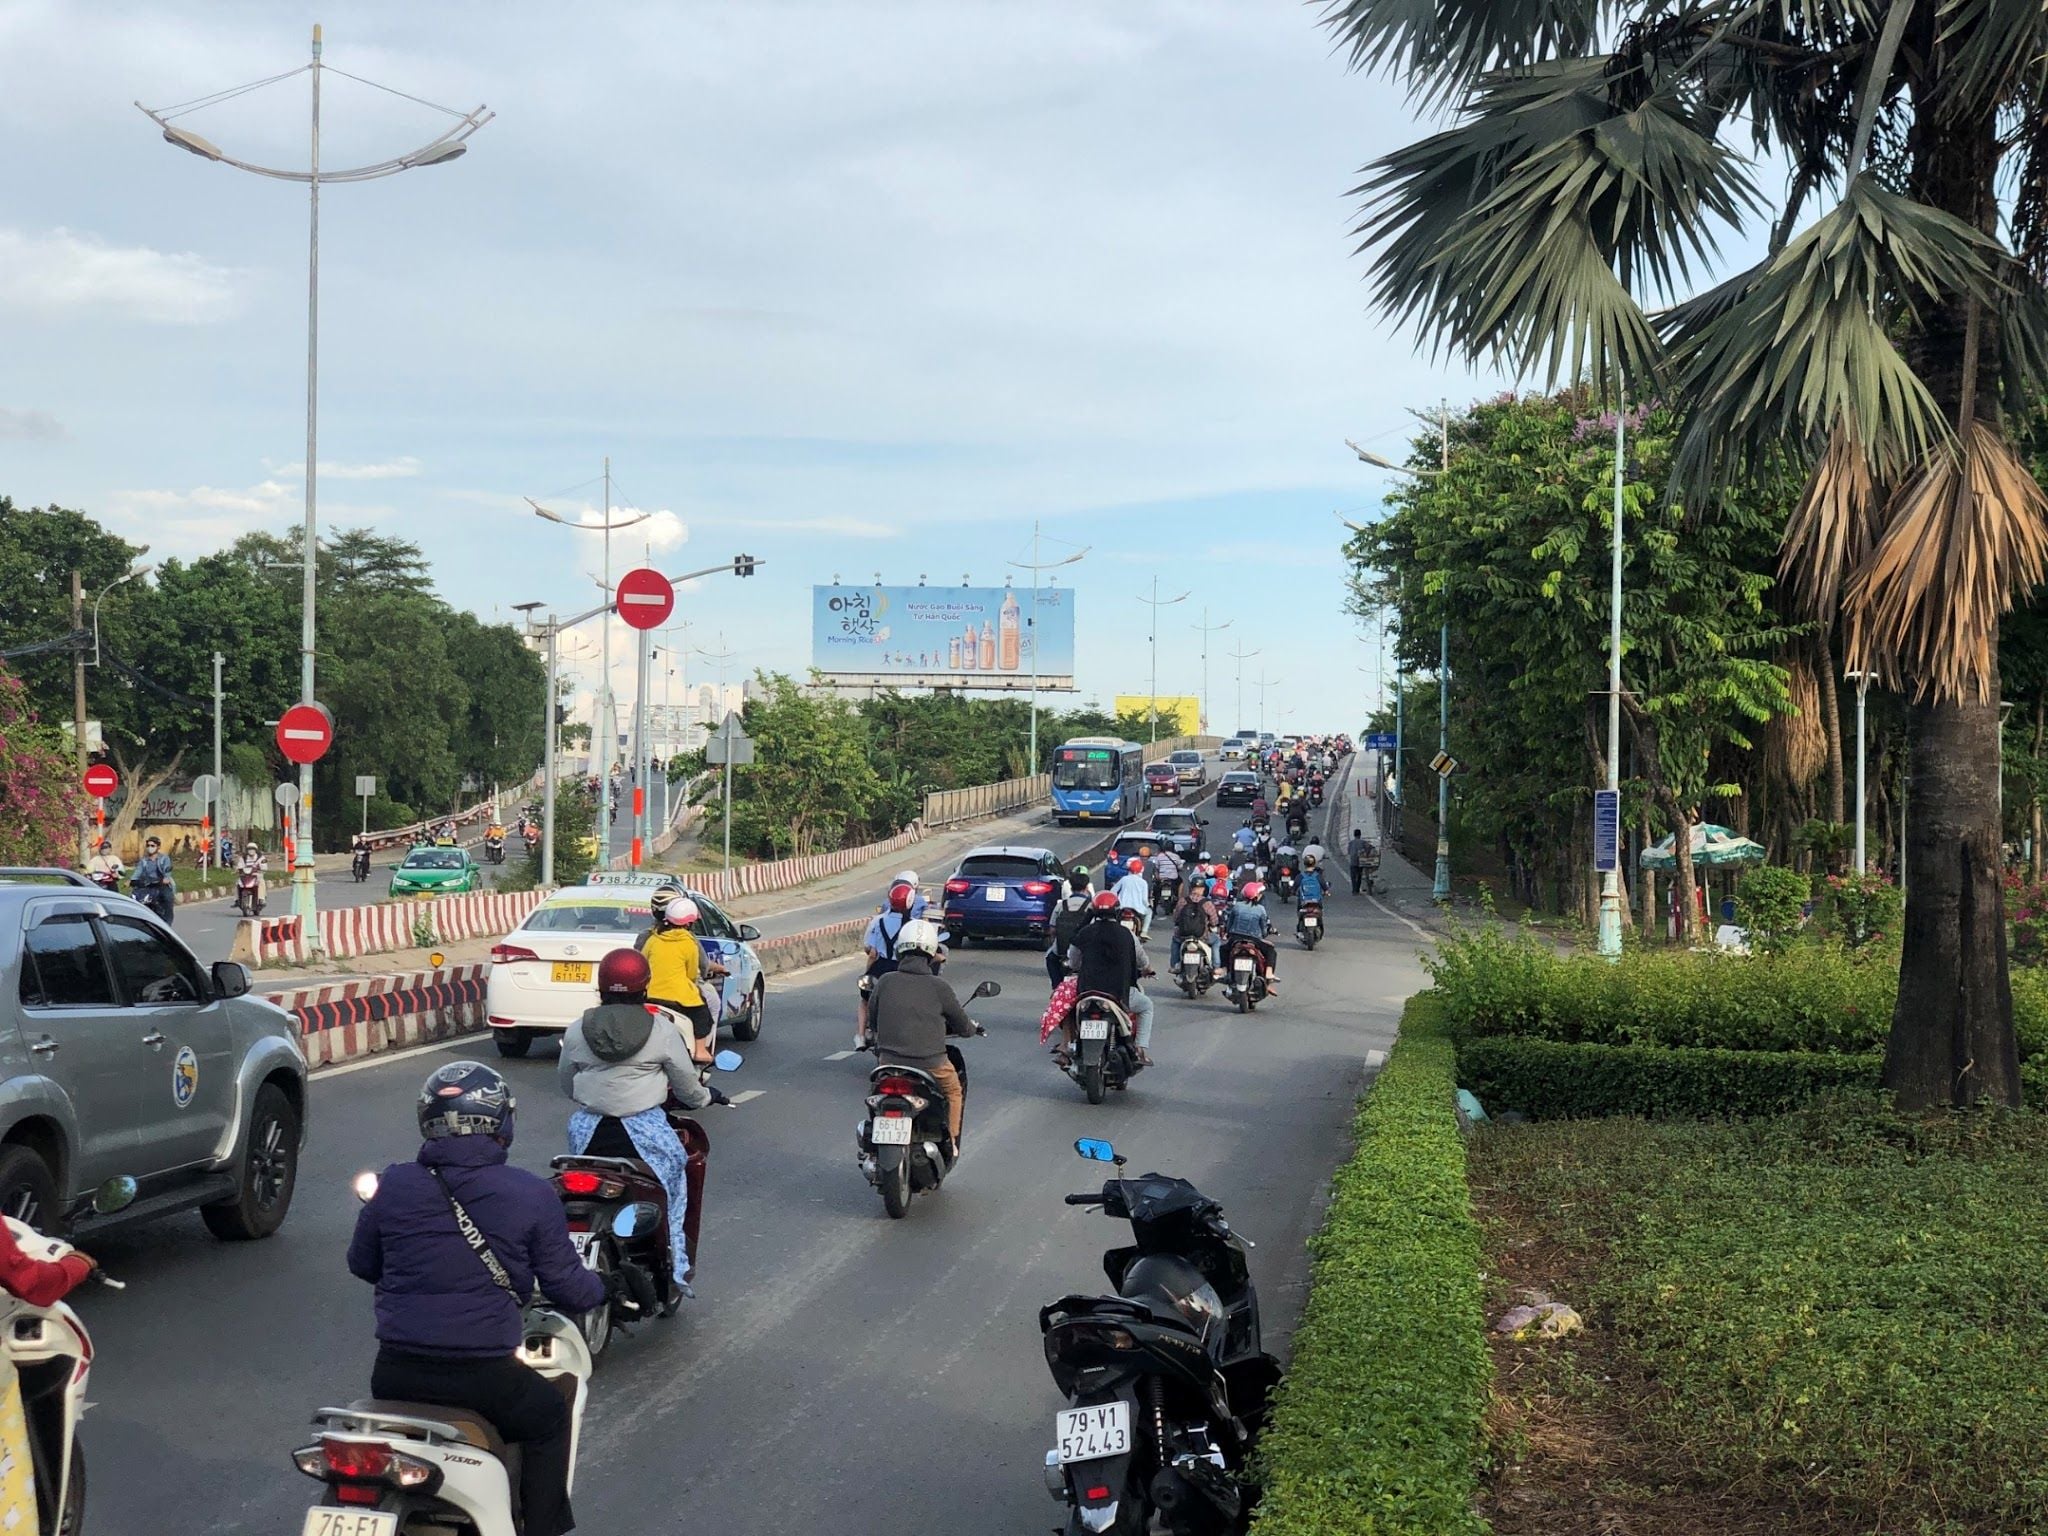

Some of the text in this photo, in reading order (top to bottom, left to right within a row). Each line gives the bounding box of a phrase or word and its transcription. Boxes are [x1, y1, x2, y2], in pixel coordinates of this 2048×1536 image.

[829, 592, 870, 618] 아침
[841, 617, 880, 635] 햇살
[828, 636, 856, 645] Morning
[564, 963, 581, 972] 51H
[879, 1120, 905, 1130] 66-L1
[874, 1131, 908, 1142] 211.37
[1083, 1366, 1106, 1374] HONDA
[1068, 1406, 1117, 1435] 79-V1
[1062, 1429, 1125, 1459] 524.43
[443, 1453, 483, 1467] VISION
